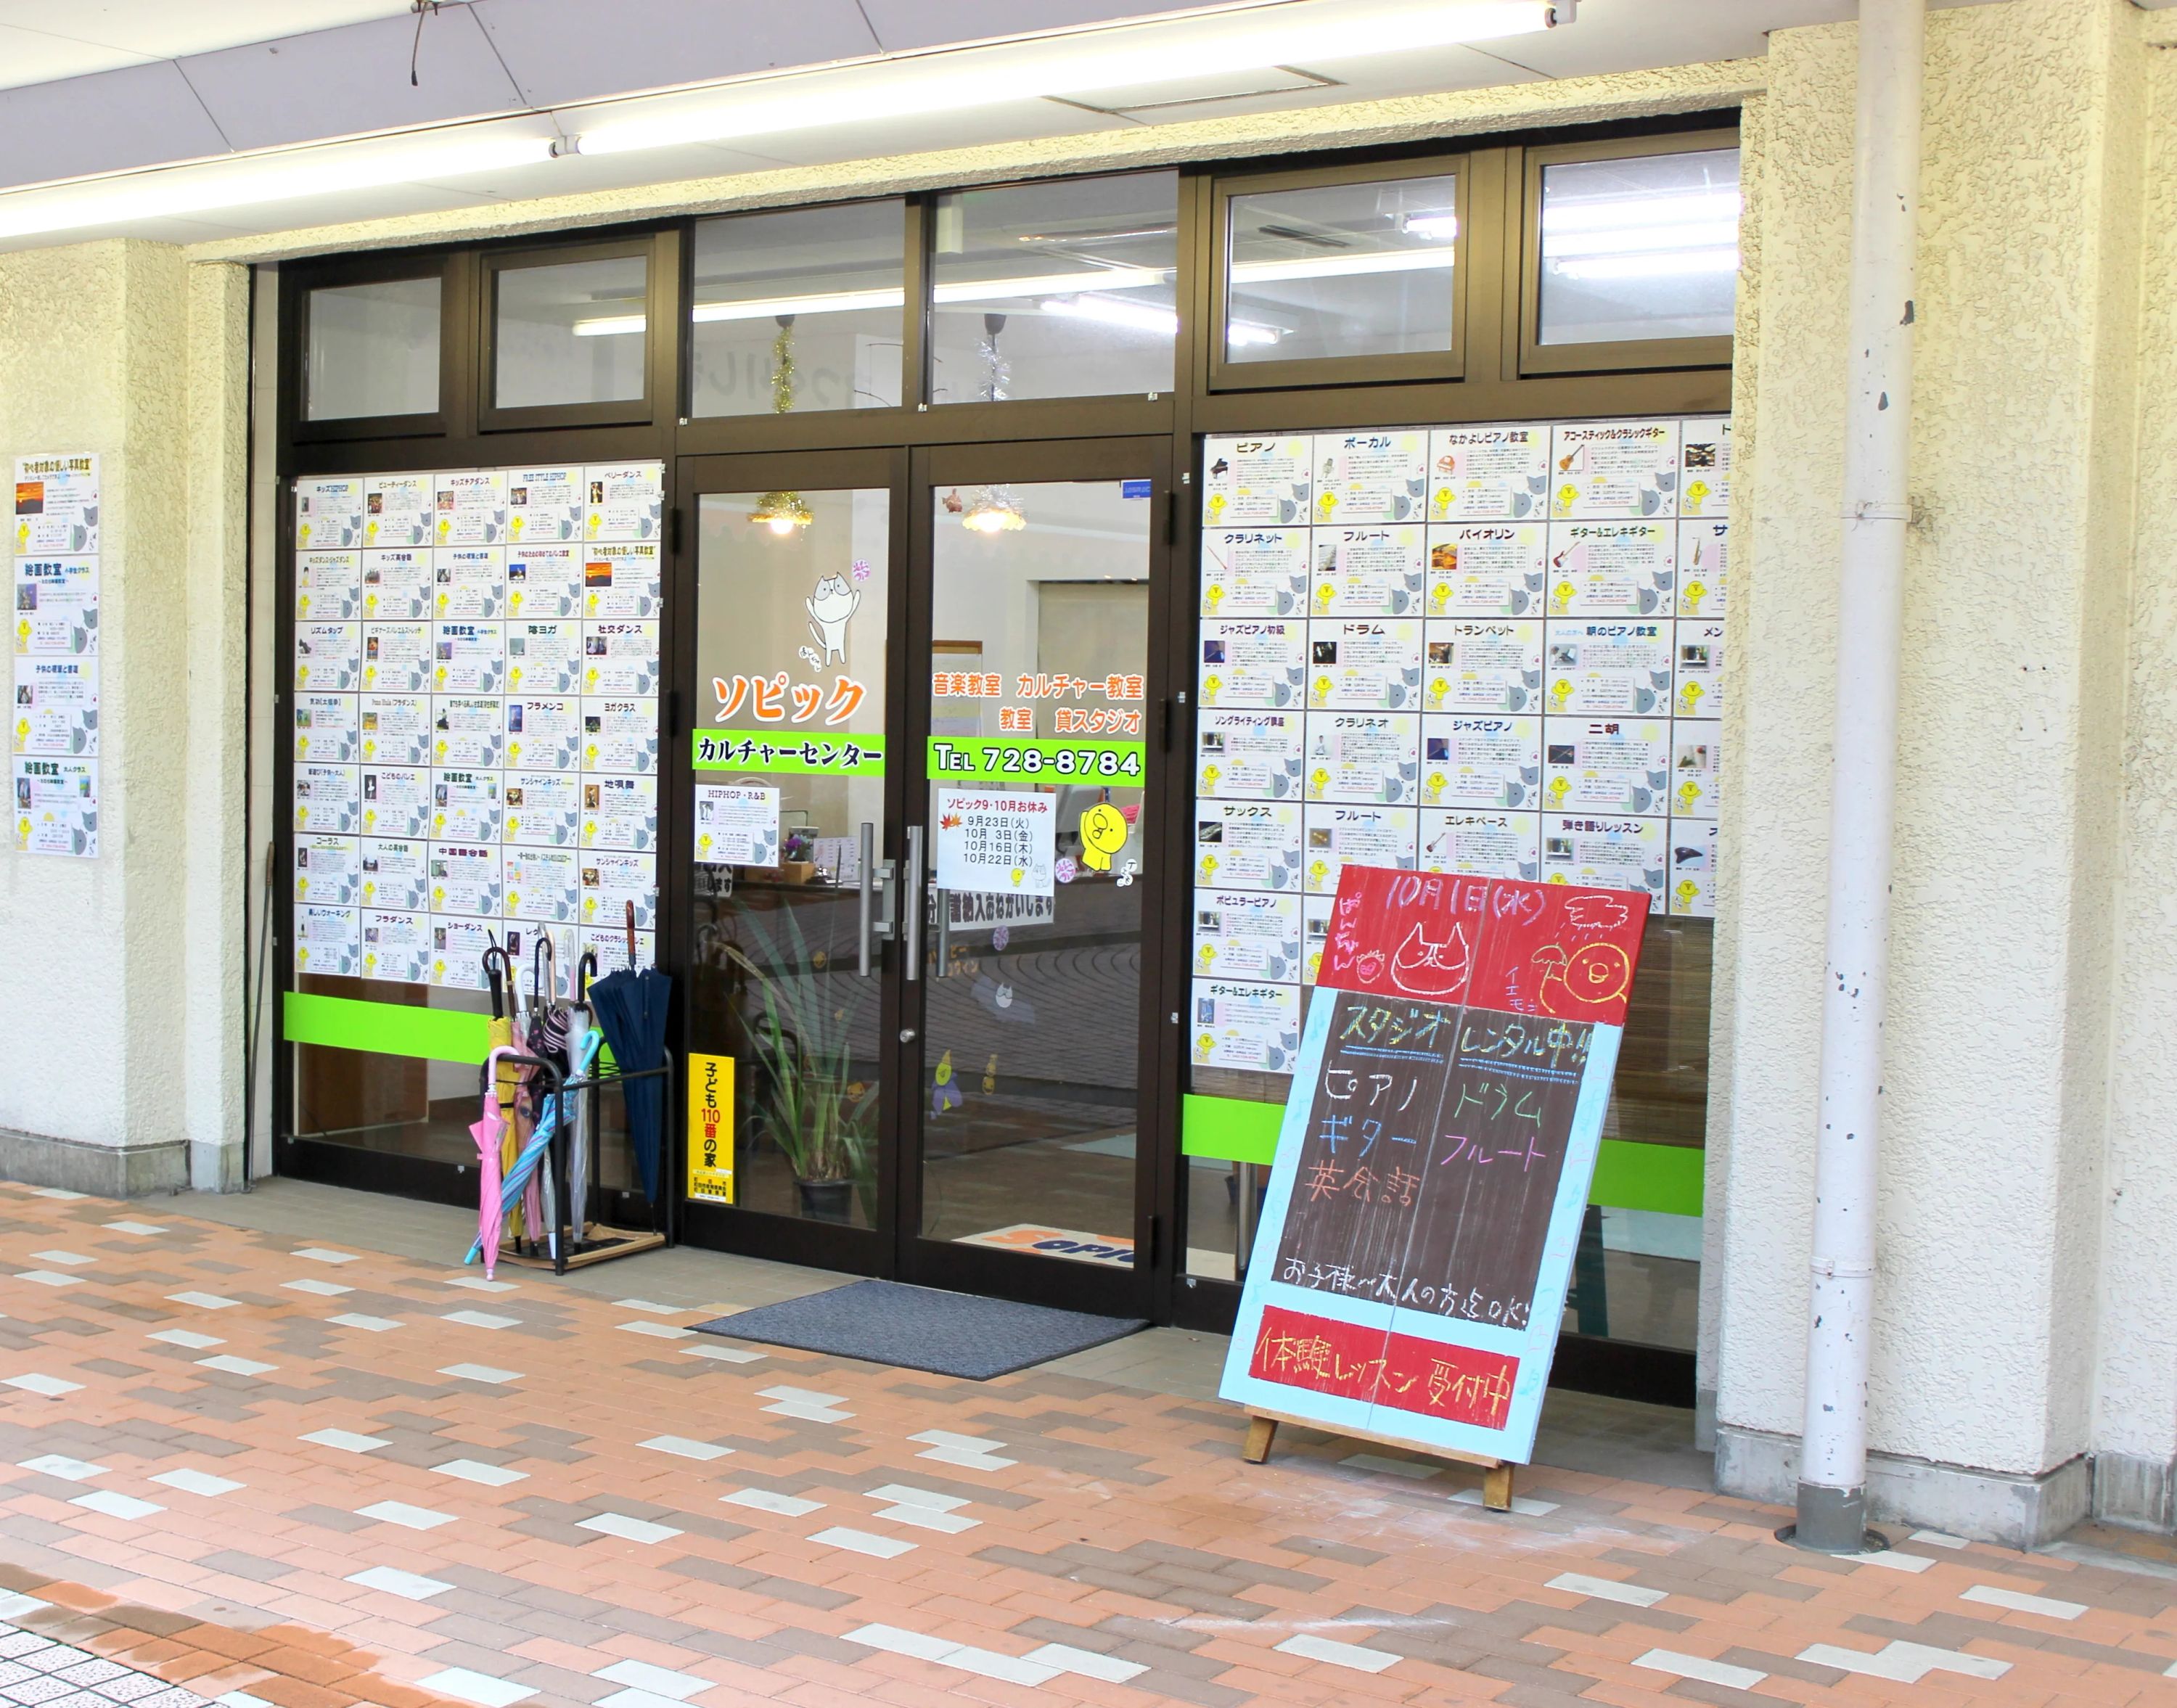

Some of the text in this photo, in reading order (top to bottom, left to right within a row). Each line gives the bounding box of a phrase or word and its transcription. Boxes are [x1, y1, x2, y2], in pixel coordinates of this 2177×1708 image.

[1344, 437, 1392, 449] ボーカル
[1449, 431, 1529, 445] なかよしピアノ教室
[1236, 442, 1277, 453] ピアノ
[378, 480, 417, 488] ビューティーダンス
[450, 477, 491, 485] キッズチアダンス
[1224, 533, 1282, 544] クラリネット
[1343, 530, 1390, 541] フルート
[1459, 528, 1515, 540] バイオリン
[1570, 527, 1656, 538] ギター&エレキギター
[311, 626, 343, 635] リズムタップ
[598, 625, 643, 634] 社交ダンス
[1220, 624, 1285, 635] ジャズピアノ初級
[1343, 624, 1386, 635] ドラム
[1454, 624, 1514, 636] トランペット
[1586, 625, 1657, 637] 朝のピアノ教室
[932, 673, 1144, 700] 音楽教室 カルチャー教室
[713, 672, 866, 725] ソピック
[527, 702, 564, 711] フラメンコ
[604, 703, 636, 713] ヨガクラス
[999, 706, 1141, 734] 教室 貸スタジオ
[1335, 717, 1389, 728] クラリネオ
[1453, 720, 1513, 733] ジャズピアノ
[698, 737, 882, 768] カルチャーセンター
[934, 744, 1141, 776] TEL 728-8784
[1224, 805, 1272, 818] サックス
[1335, 810, 1382, 821] フルート
[968, 816, 1030, 829] 9月23日(火)
[1445, 815, 1508, 828] エレキベース
[1562, 819, 1644, 834] 弾き語りレッスン
[964, 841, 1033, 855] 10月16日(木)
[963, 853, 1033, 867] 10月22日(水)
[1386, 875, 1546, 926] 10月1日(水)
[375, 914, 414, 925] フラダンス
[448, 921, 483, 932] ショーダンス
[1340, 1006, 1452, 1049] スタジオ
[1325, 1059, 1418, 1112] ピアノ
[1454, 1083, 1543, 1128] ドラム
[701, 1062, 721, 1168] 子ども110番の家
[1318, 1114, 1417, 1158] ギター
[1440, 1134, 1547, 1173] フルート
[1304, 1159, 1421, 1207] 英会話
[1256, 1326, 1511, 1417] 体験レッスン 受付中
